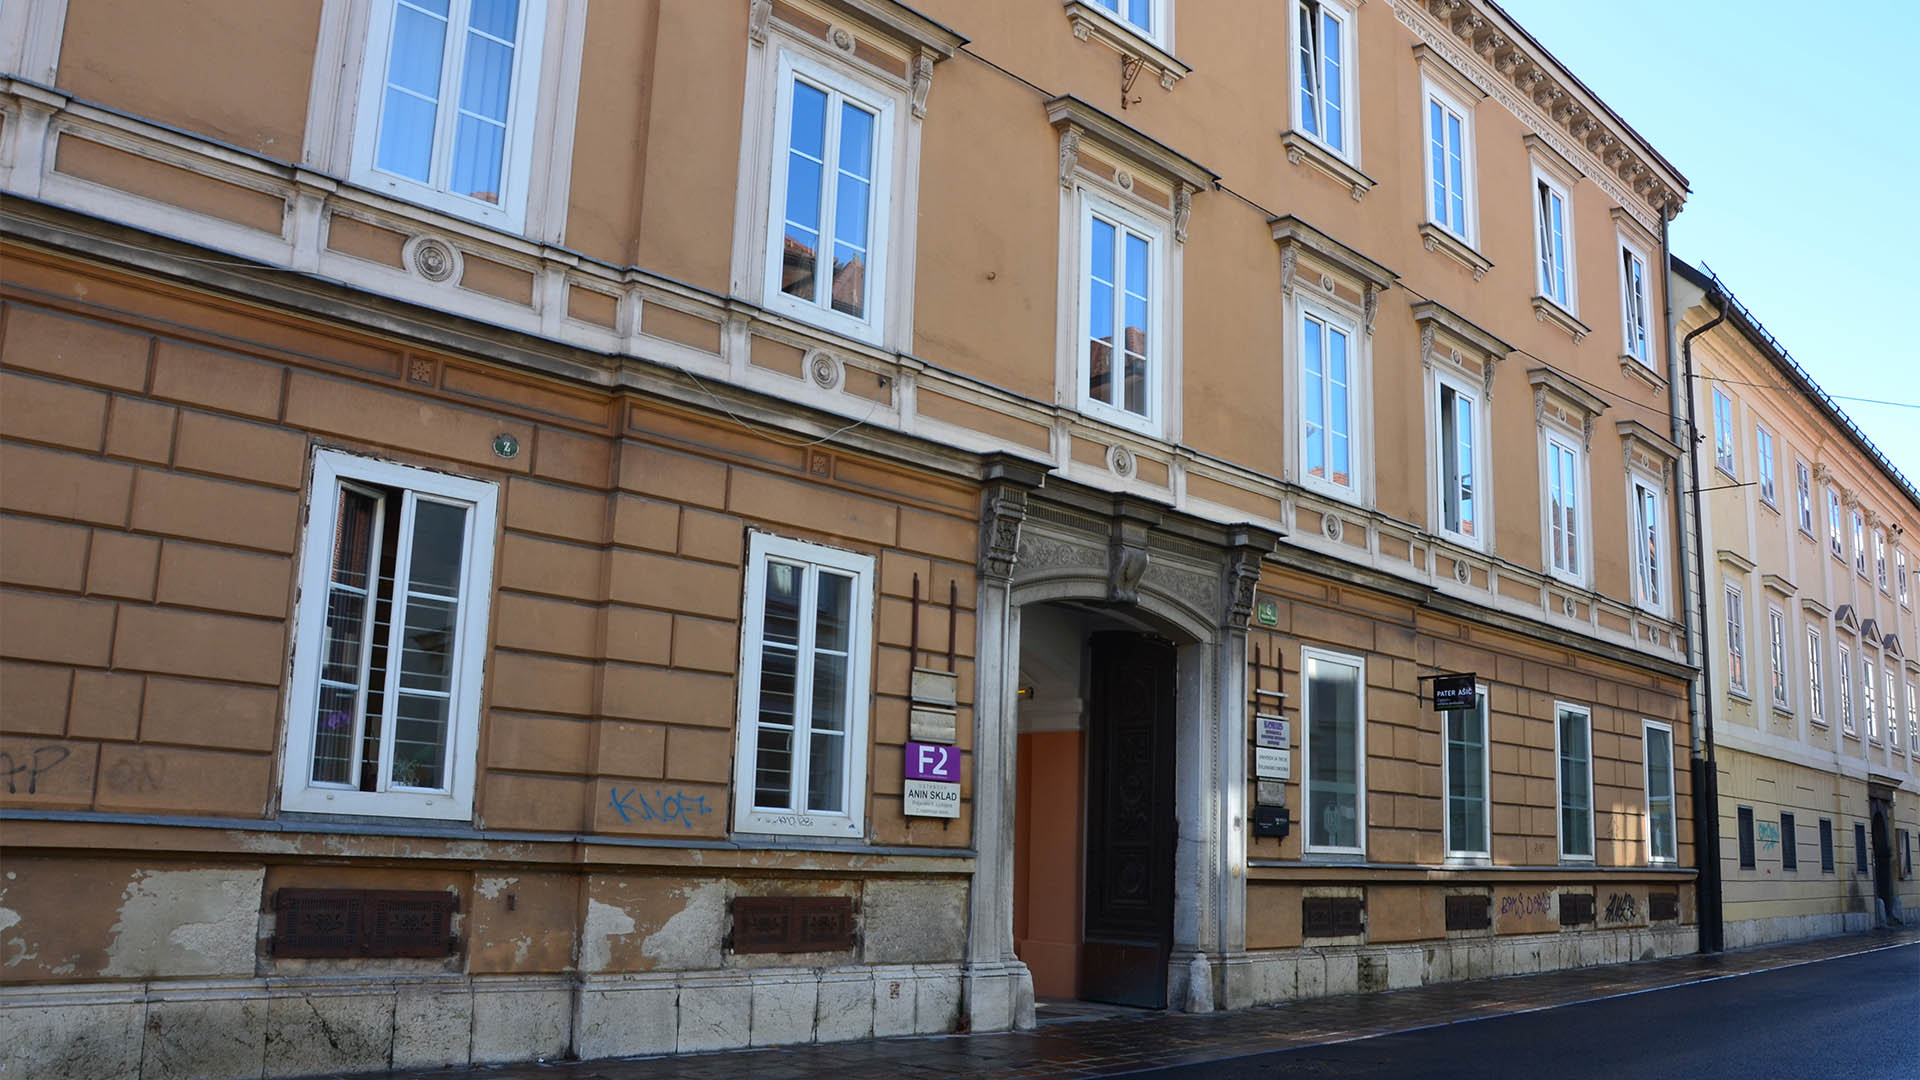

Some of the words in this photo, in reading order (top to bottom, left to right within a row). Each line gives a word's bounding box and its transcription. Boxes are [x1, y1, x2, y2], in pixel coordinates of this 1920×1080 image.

[918, 745, 948, 775] F2
[908, 789, 928, 799] ANIN
[930, 790, 957, 801] SKLAD
